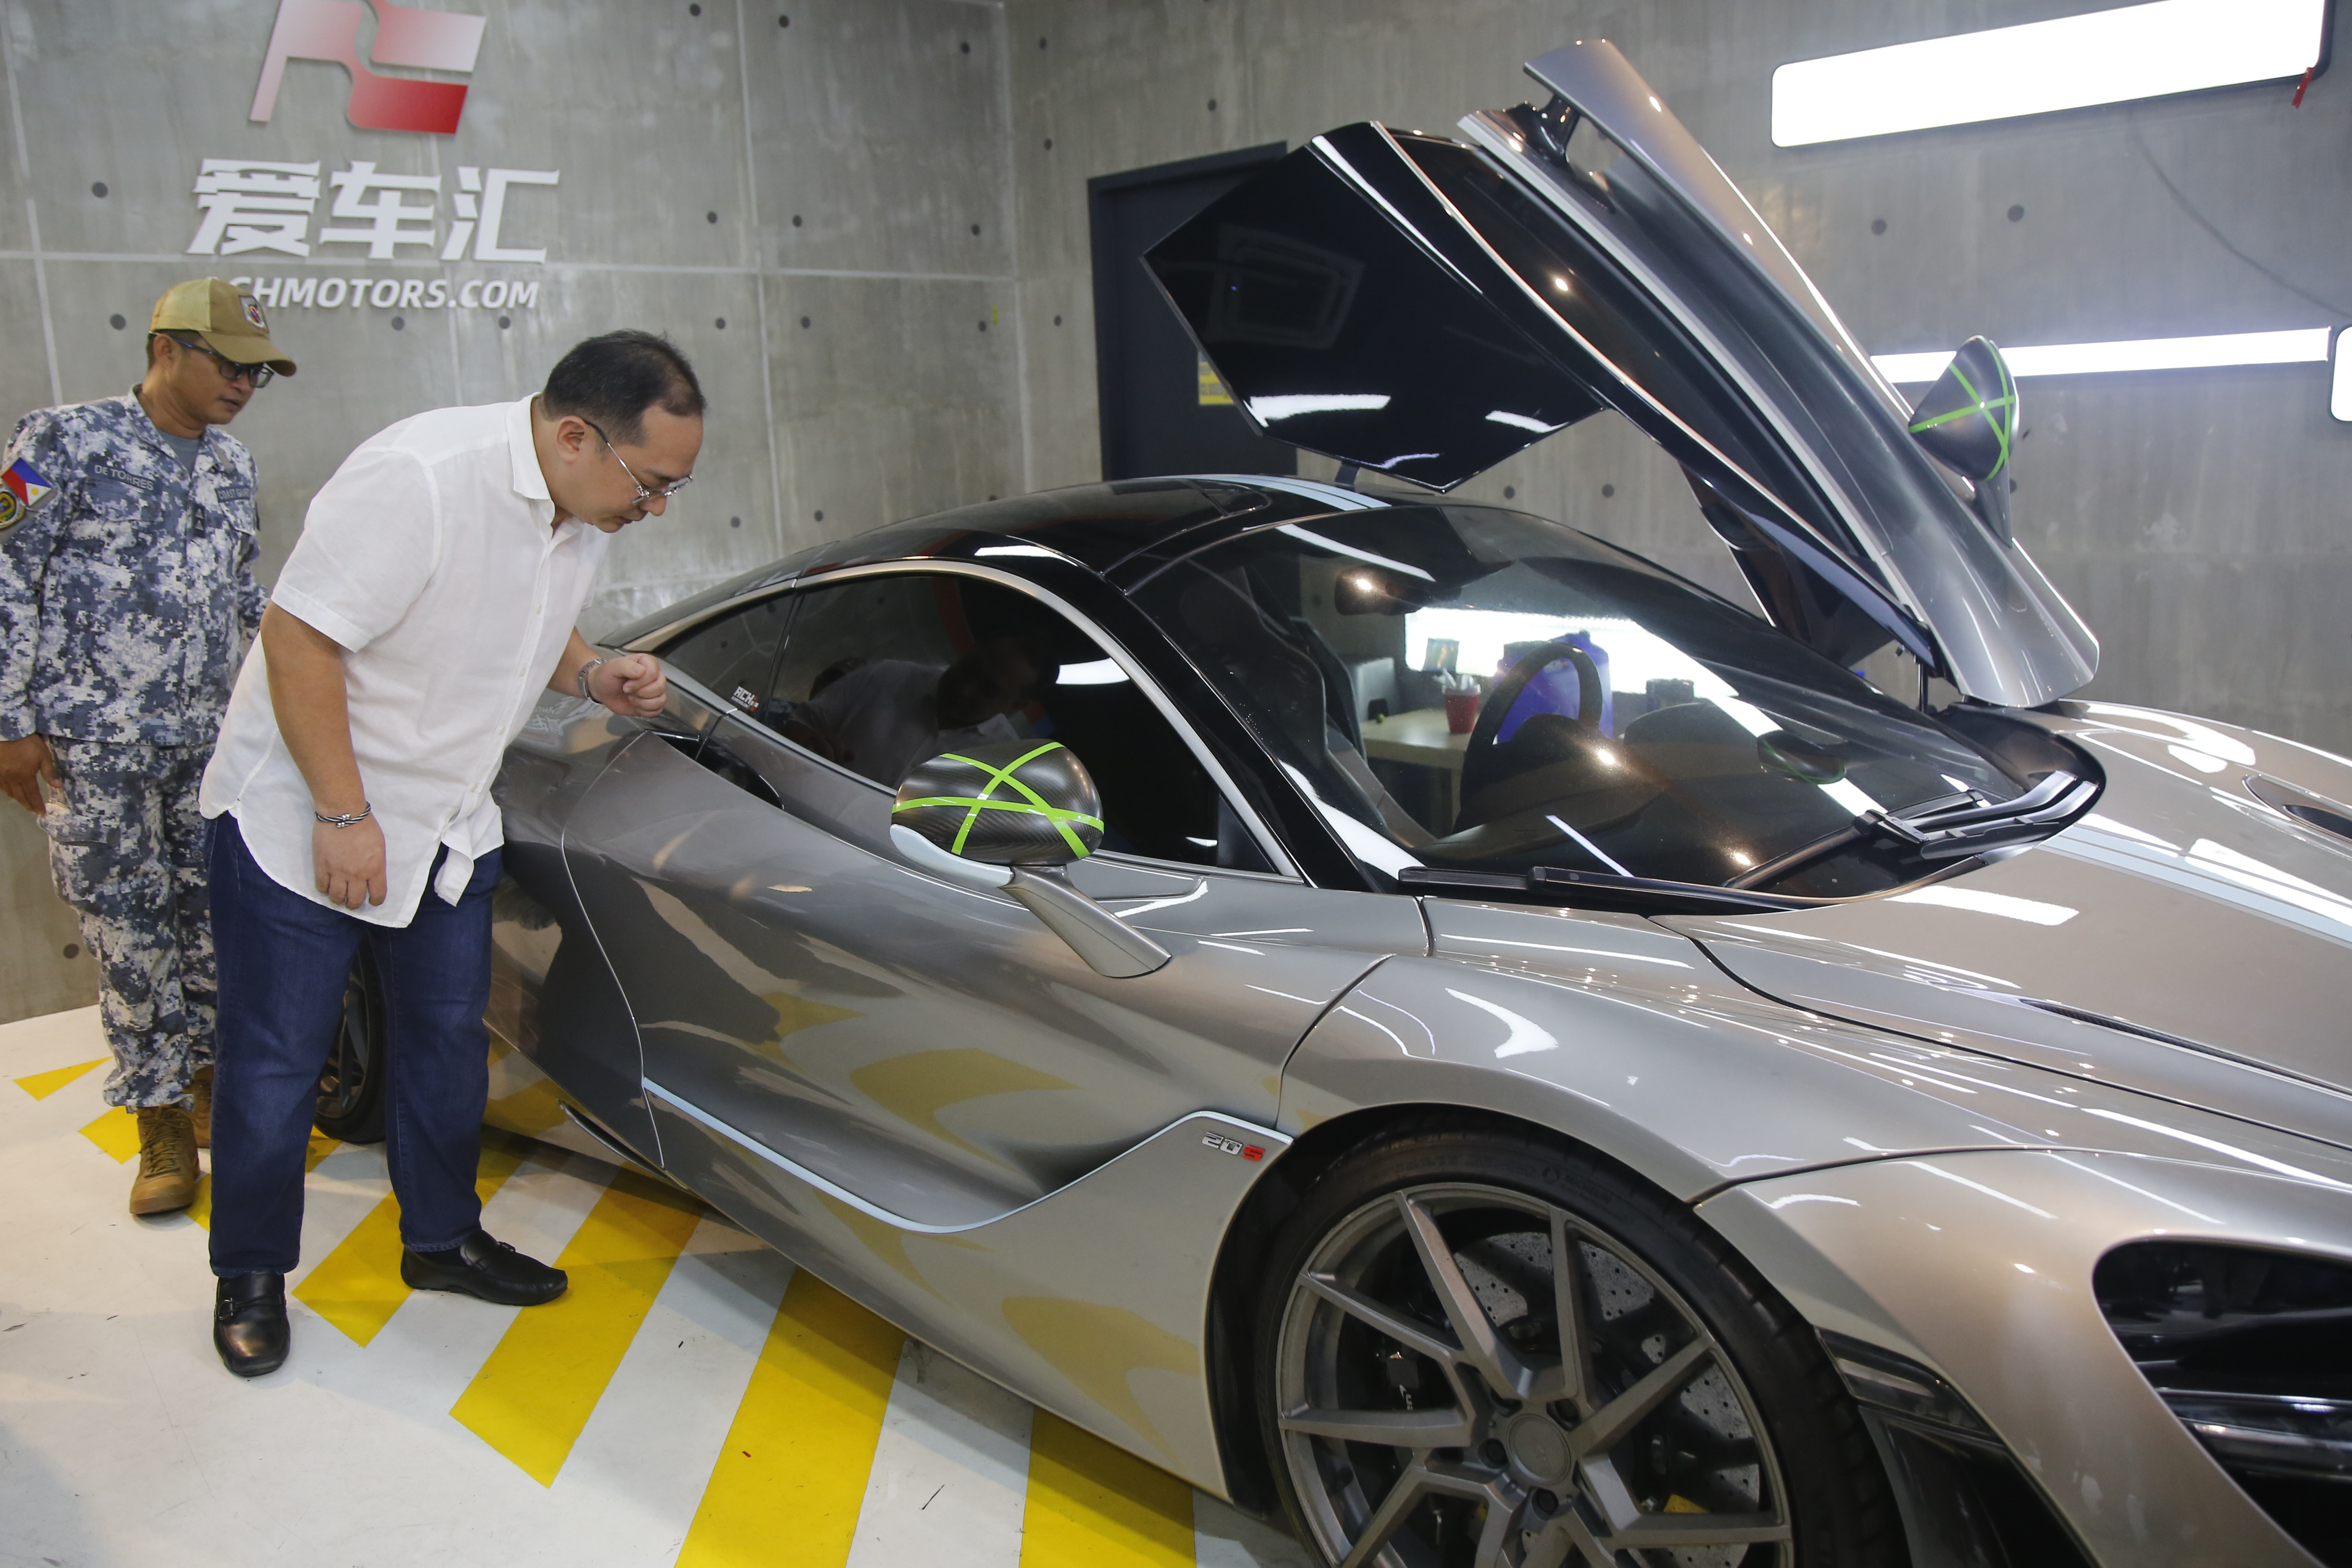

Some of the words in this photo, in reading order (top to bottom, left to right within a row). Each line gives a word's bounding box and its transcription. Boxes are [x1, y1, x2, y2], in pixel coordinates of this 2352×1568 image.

[186, 158, 560, 265] 爱车汇
[207, 277, 539, 309] HMOTORS.COM
[94, 465, 108, 475] DE
[110, 468, 154, 491] TORRES
